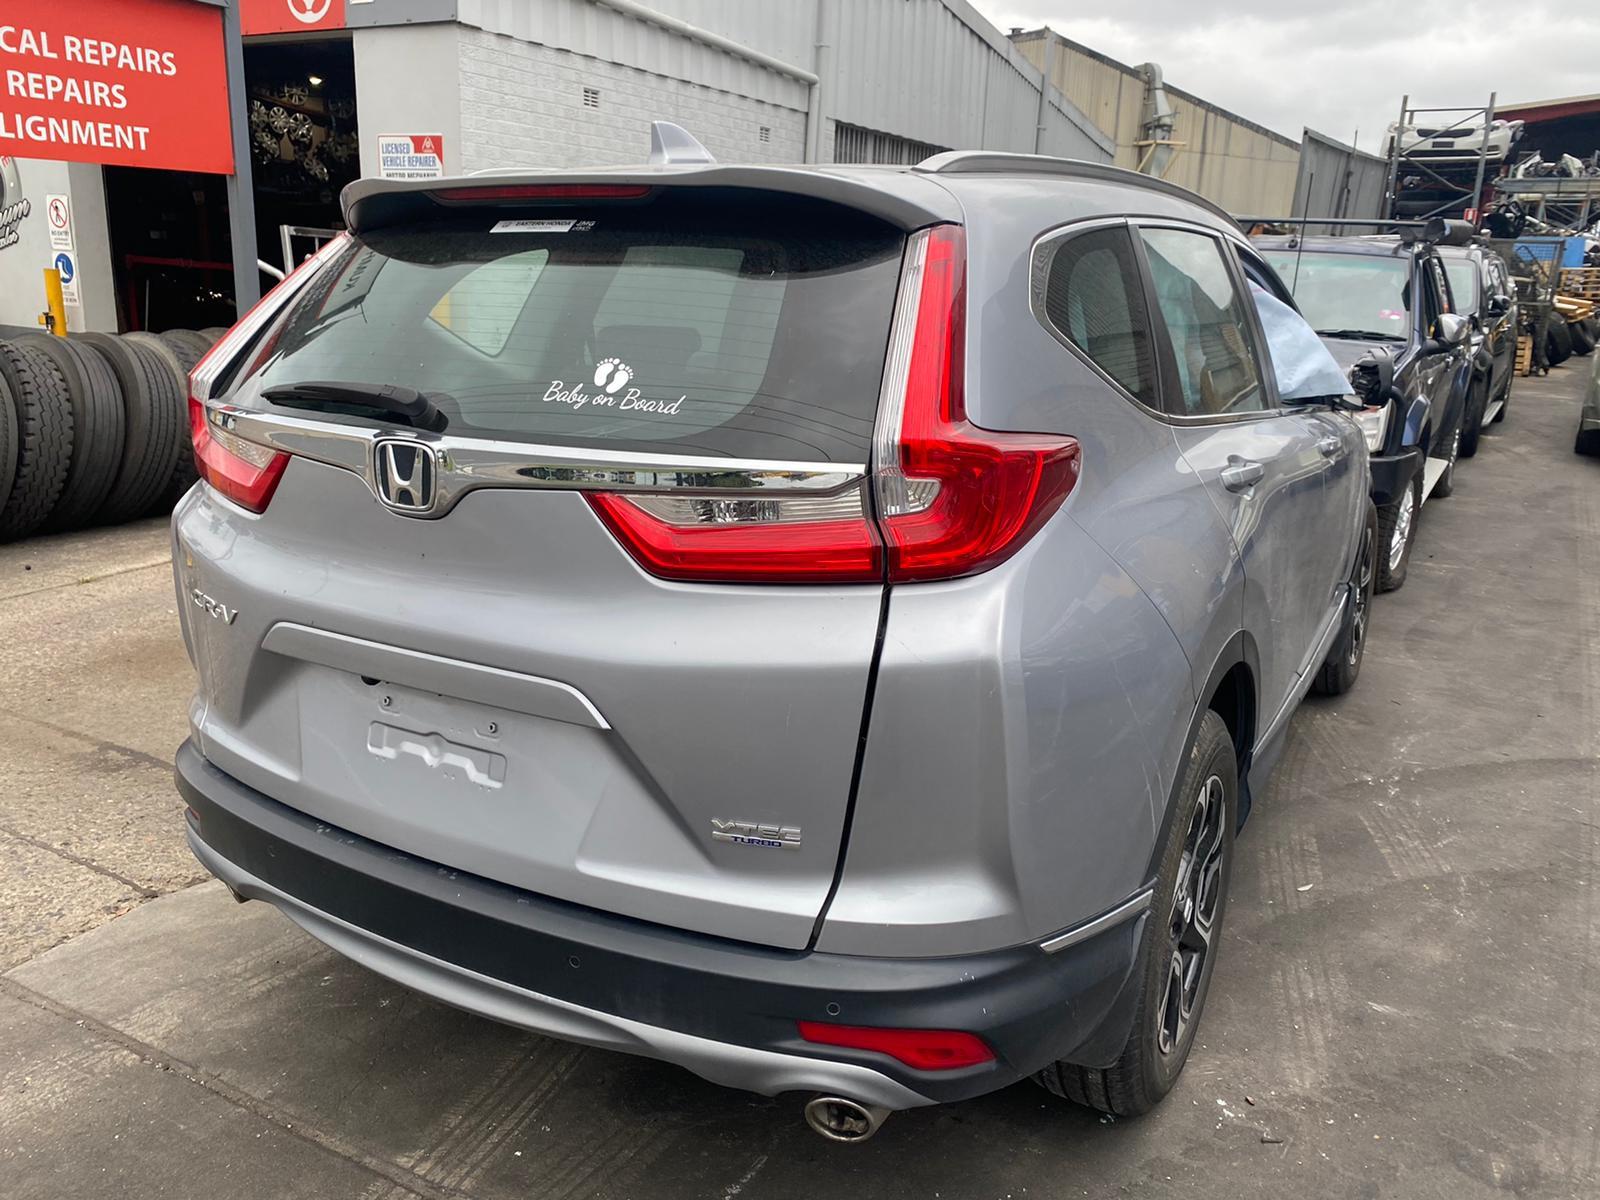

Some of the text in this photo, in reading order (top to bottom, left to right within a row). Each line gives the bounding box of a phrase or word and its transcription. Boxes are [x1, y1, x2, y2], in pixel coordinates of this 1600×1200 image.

[0, 25, 177, 76] CAL REPAIRS
[6, 69, 128, 109] REPAIRS
[0, 111, 150, 151] LIGNMENT
[382, 143, 410, 154] LICENSED
[382, 155, 437, 167] VEHICLE REPAIRER
[543, 380, 687, 415] Baby on Board
[711, 817, 801, 842] VTEC
[731, 835, 782, 849] TURBO
